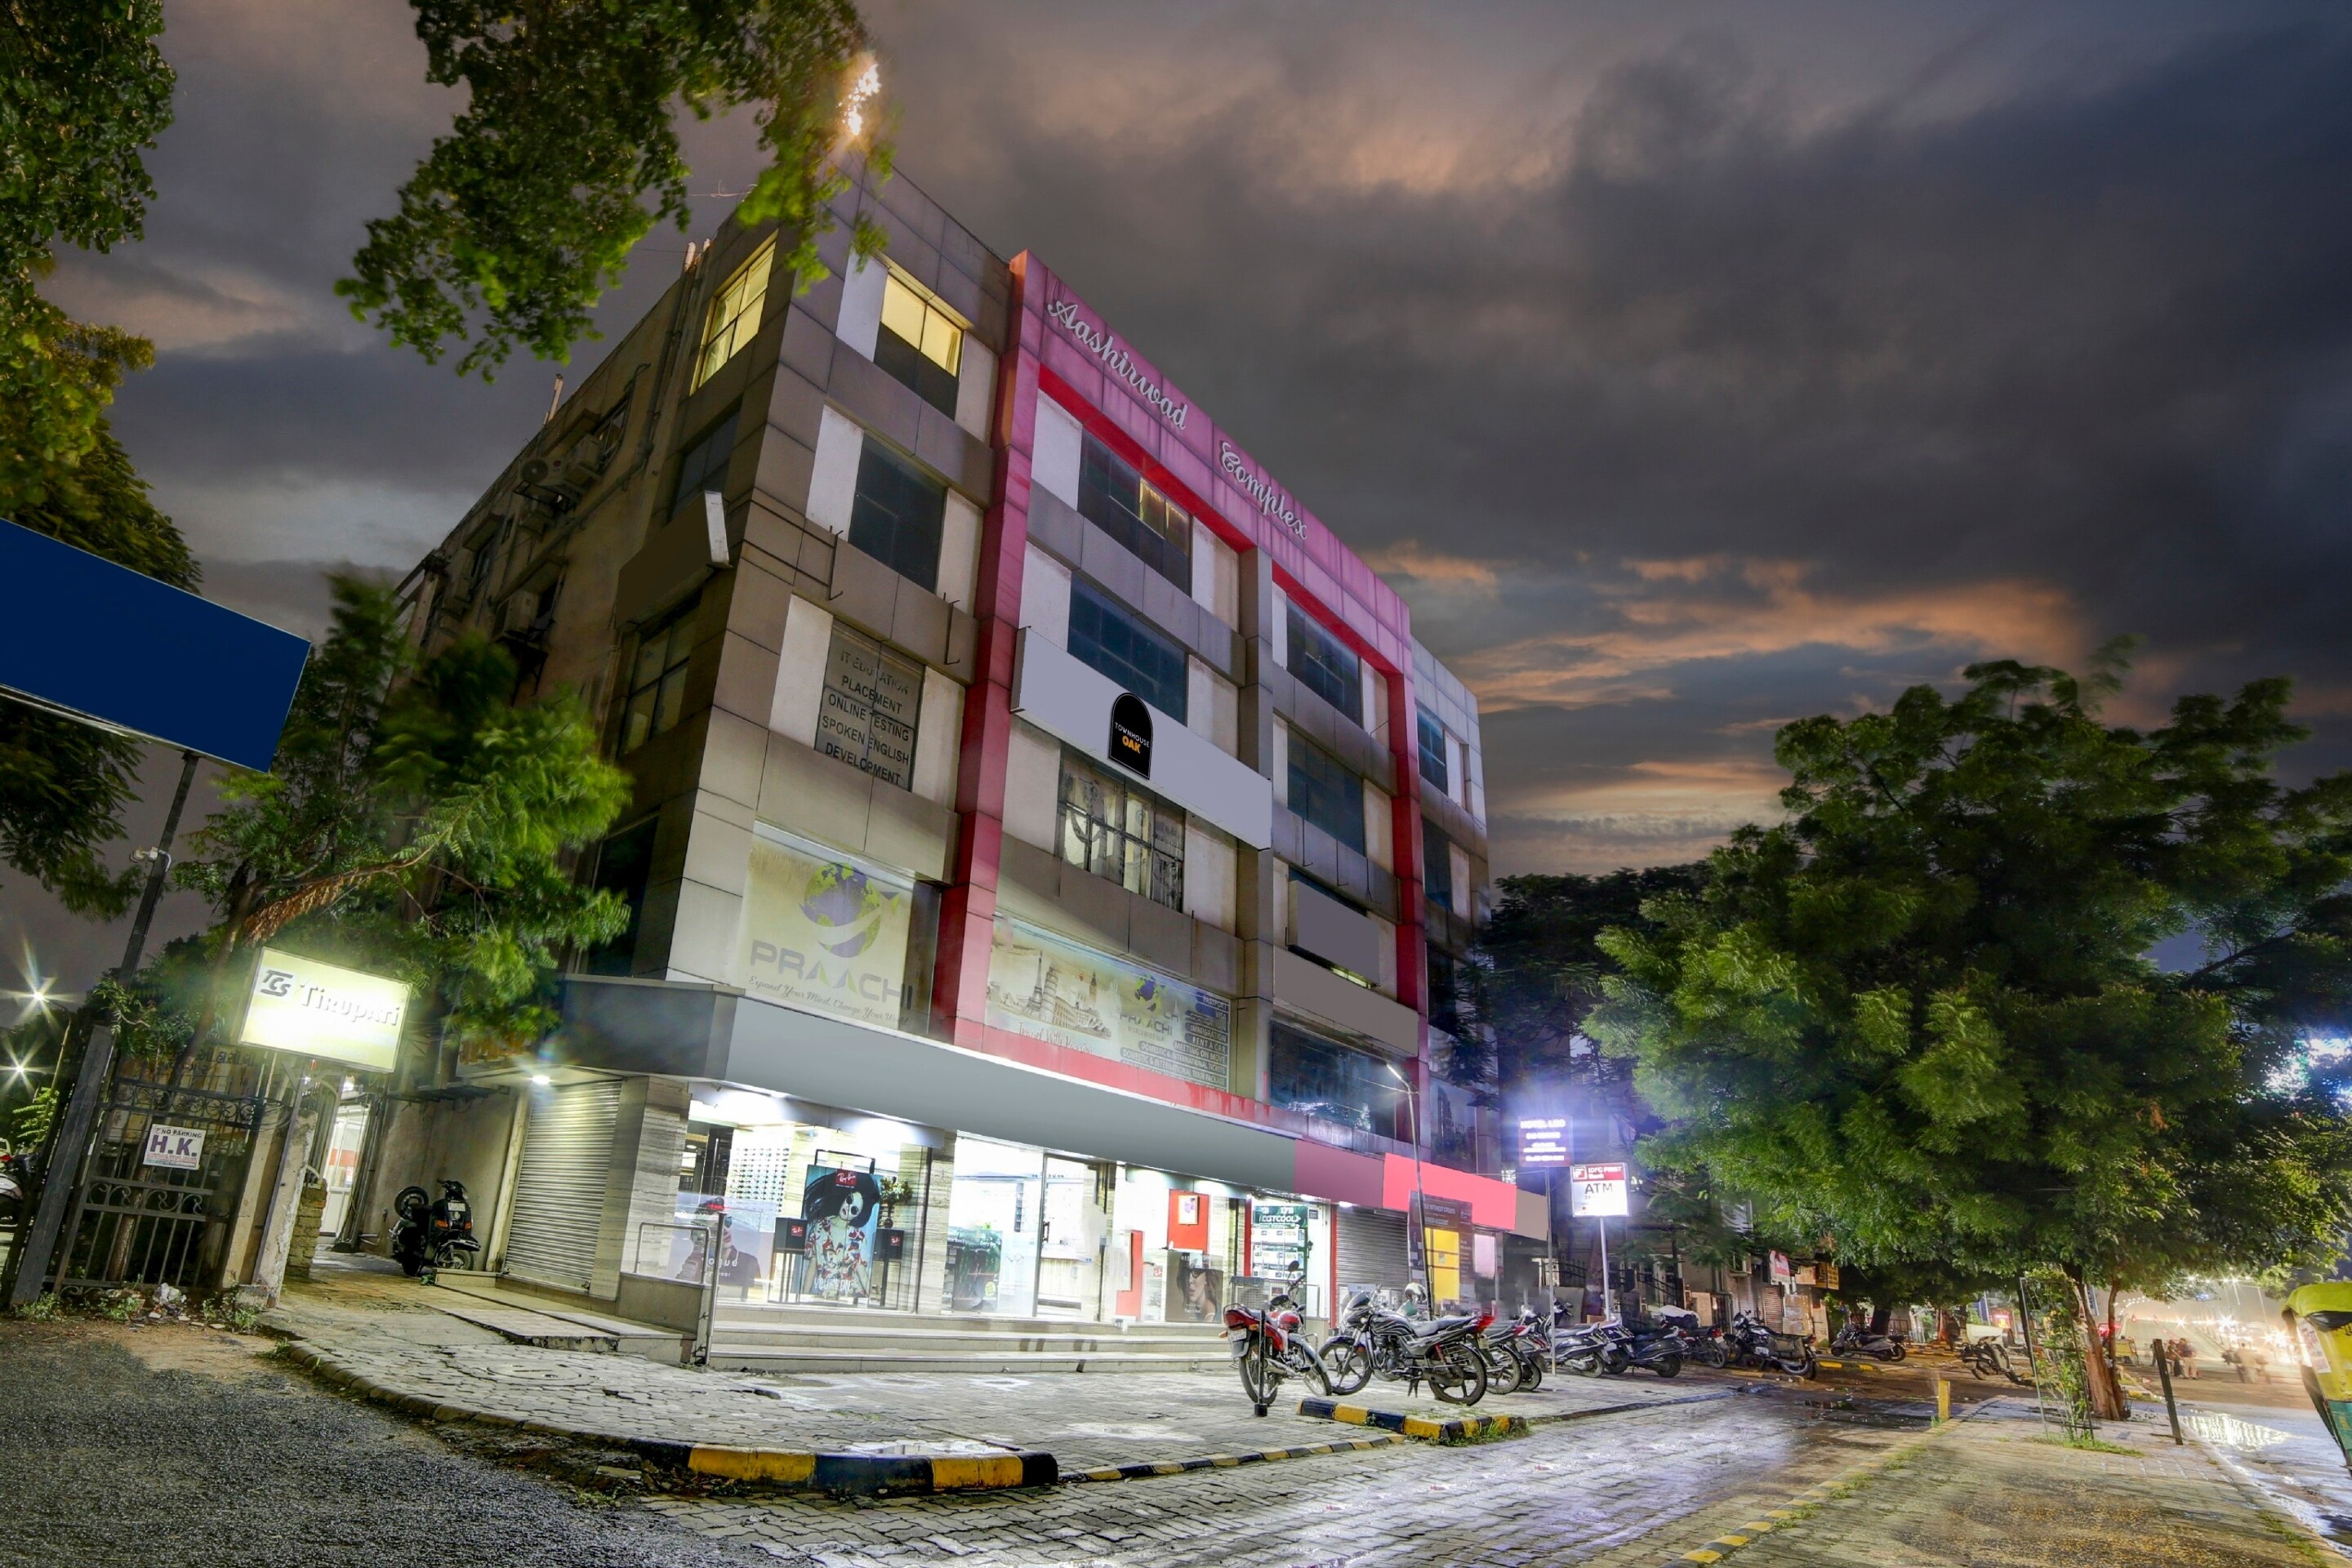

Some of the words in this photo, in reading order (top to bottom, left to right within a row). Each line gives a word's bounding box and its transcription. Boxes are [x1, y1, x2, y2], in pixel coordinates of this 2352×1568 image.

[1048, 301, 1188, 430] Aashirwad
[1222, 442, 1307, 540] Complex
[853, 657, 909, 694] EDUATION
[842, 675, 902, 715] PLACEMENT
[828, 693, 867, 721] ONLINE
[822, 715, 866, 745] SPOKEN
[867, 737, 909, 766] ENGLISH
[1115, 721, 1150, 748] TOWNHOUSE
[1122, 735, 1142, 754] OAK
[826, 742, 902, 786] DEVELOPMENT
[750, 939, 913, 1010] PRAACHI
[749, 975, 784, 991] Expand
[782, 984, 804, 998] Your
[832, 999, 861, 1014] Change
[862, 1006, 884, 1020] Your
[1202, 994, 1227, 1010] PASSPORT
[1215, 1011, 1227, 1020] VISA
[1190, 1024, 1227, 1042] IMMIGRATION
[1192, 1036, 1208, 1048] RENT
[1123, 1048, 1149, 1062] DOMESTIC
[1142, 1043, 1166, 1054] DOMESTIC
[1176, 1041, 1199, 1056] MEETING
[1200, 1049, 1209, 1058] ON
[1210, 1052, 1226, 1063] MOVE
[173, 1129, 202, 1138] PARKING
[149, 1134, 198, 1156] H.K.
[1584, 1183, 1613, 1194] ATM
